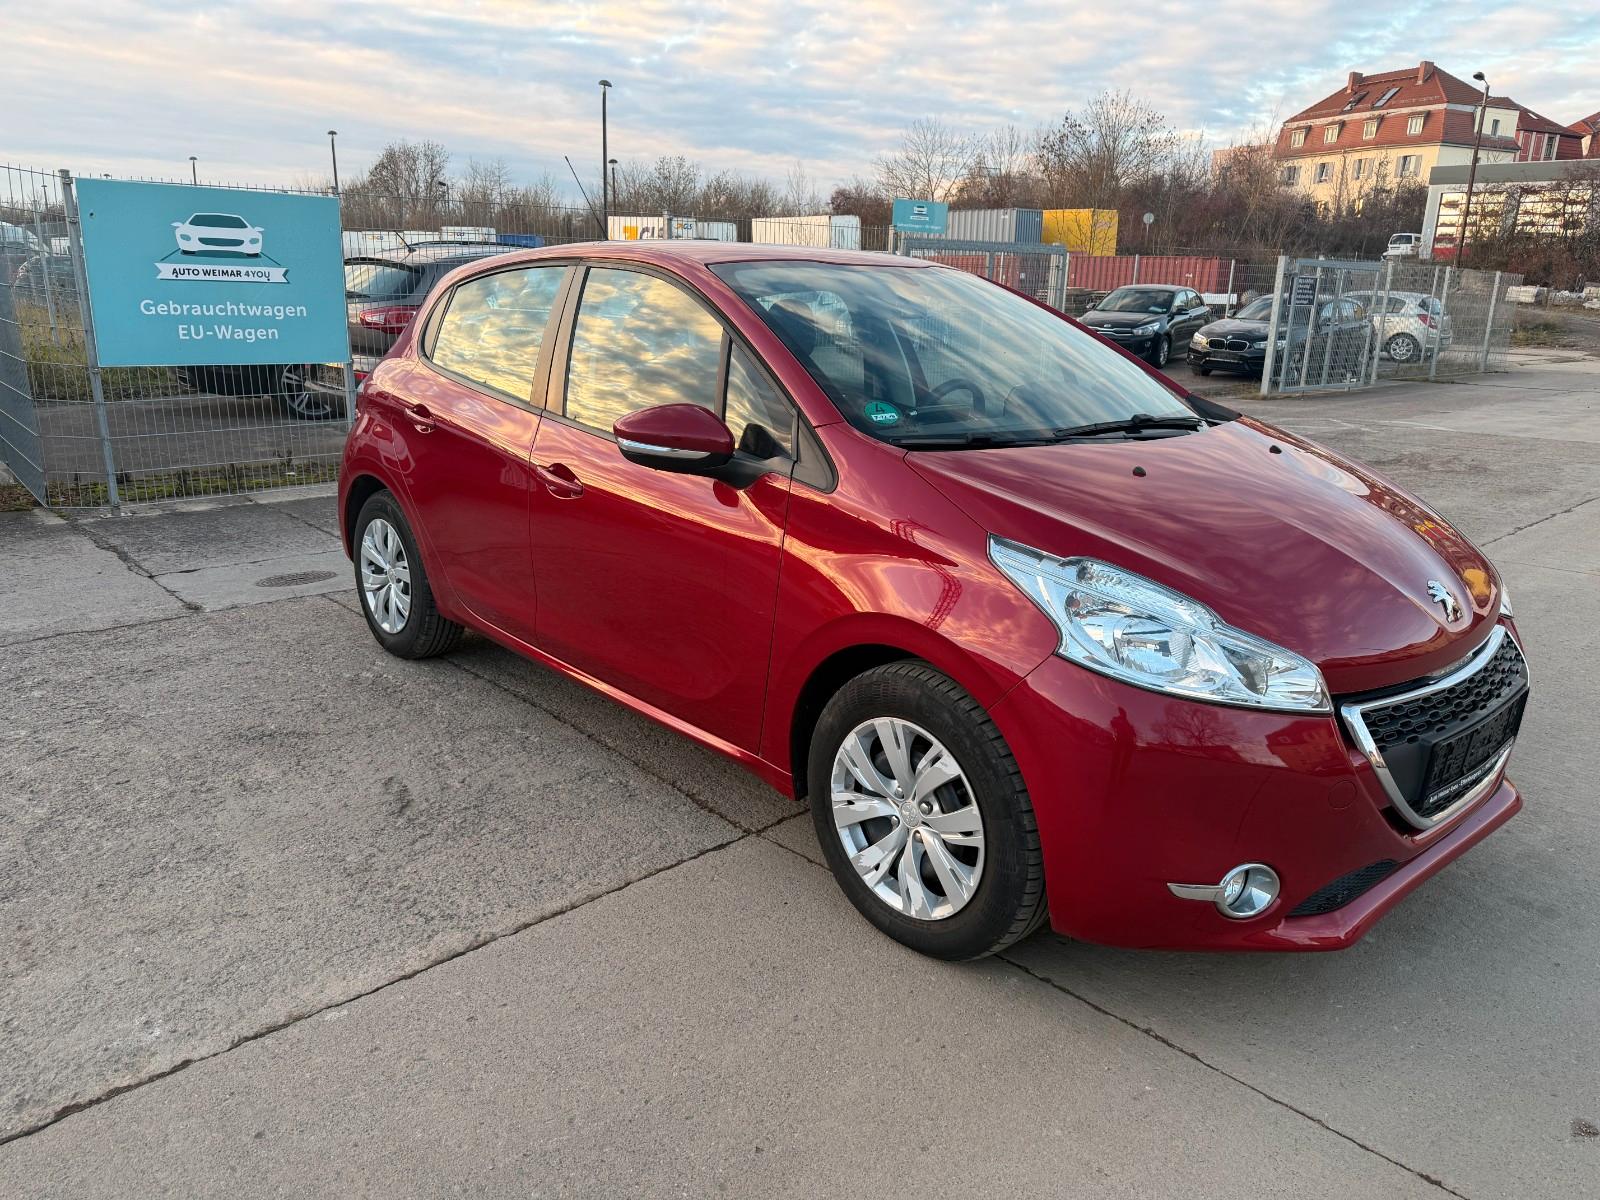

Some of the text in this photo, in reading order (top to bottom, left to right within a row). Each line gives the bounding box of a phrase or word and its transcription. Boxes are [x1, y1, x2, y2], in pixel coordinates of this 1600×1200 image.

[171, 267, 271, 281] AUTO WEIMAR 4YOU
[140, 299, 308, 320] Gebrauchtwagen
[178, 324, 279, 343] EU-Wagen
